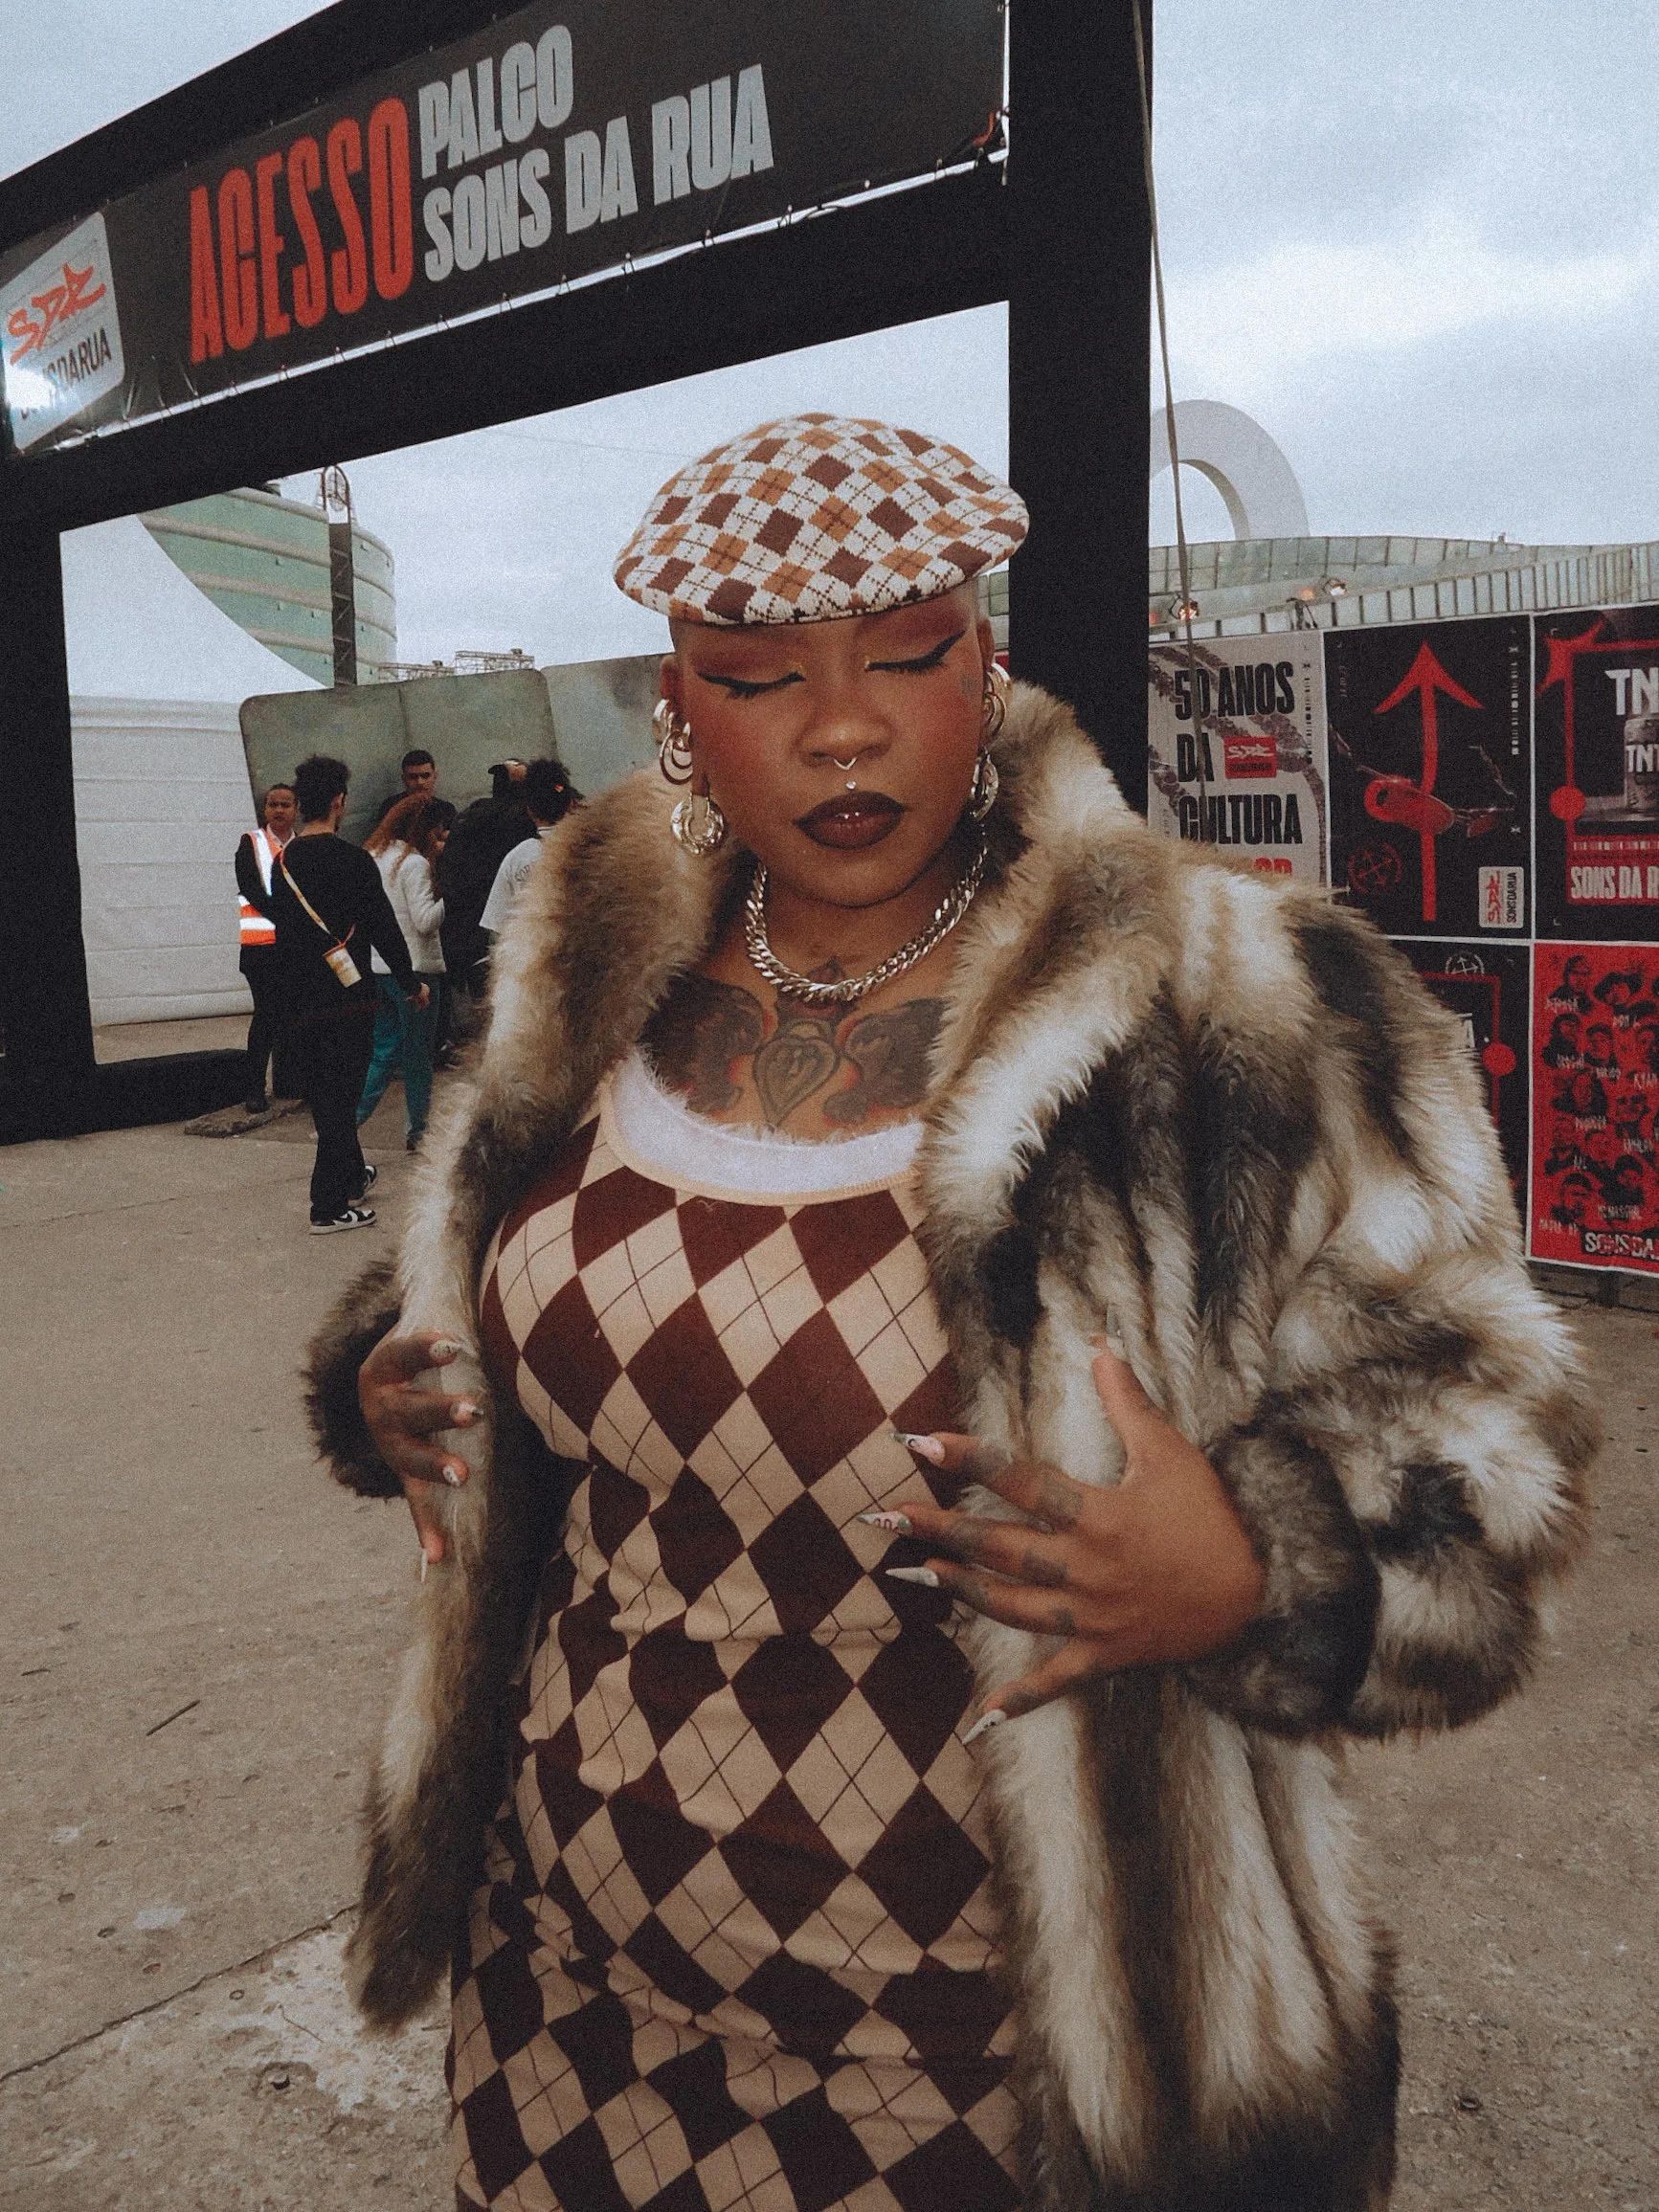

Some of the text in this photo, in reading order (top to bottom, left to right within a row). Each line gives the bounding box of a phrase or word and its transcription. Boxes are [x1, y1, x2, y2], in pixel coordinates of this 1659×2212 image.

[418, 24, 573, 179] PALCO
[424, 63, 773, 281] SONS DA RUA
[191, 97, 414, 365] ACESSO
[1175, 661, 1295, 720] 50 ANOS
[1178, 793, 1303, 844] CULTURA
[1571, 866, 1616, 899] SONS
[1619, 866, 1643, 898] DA
